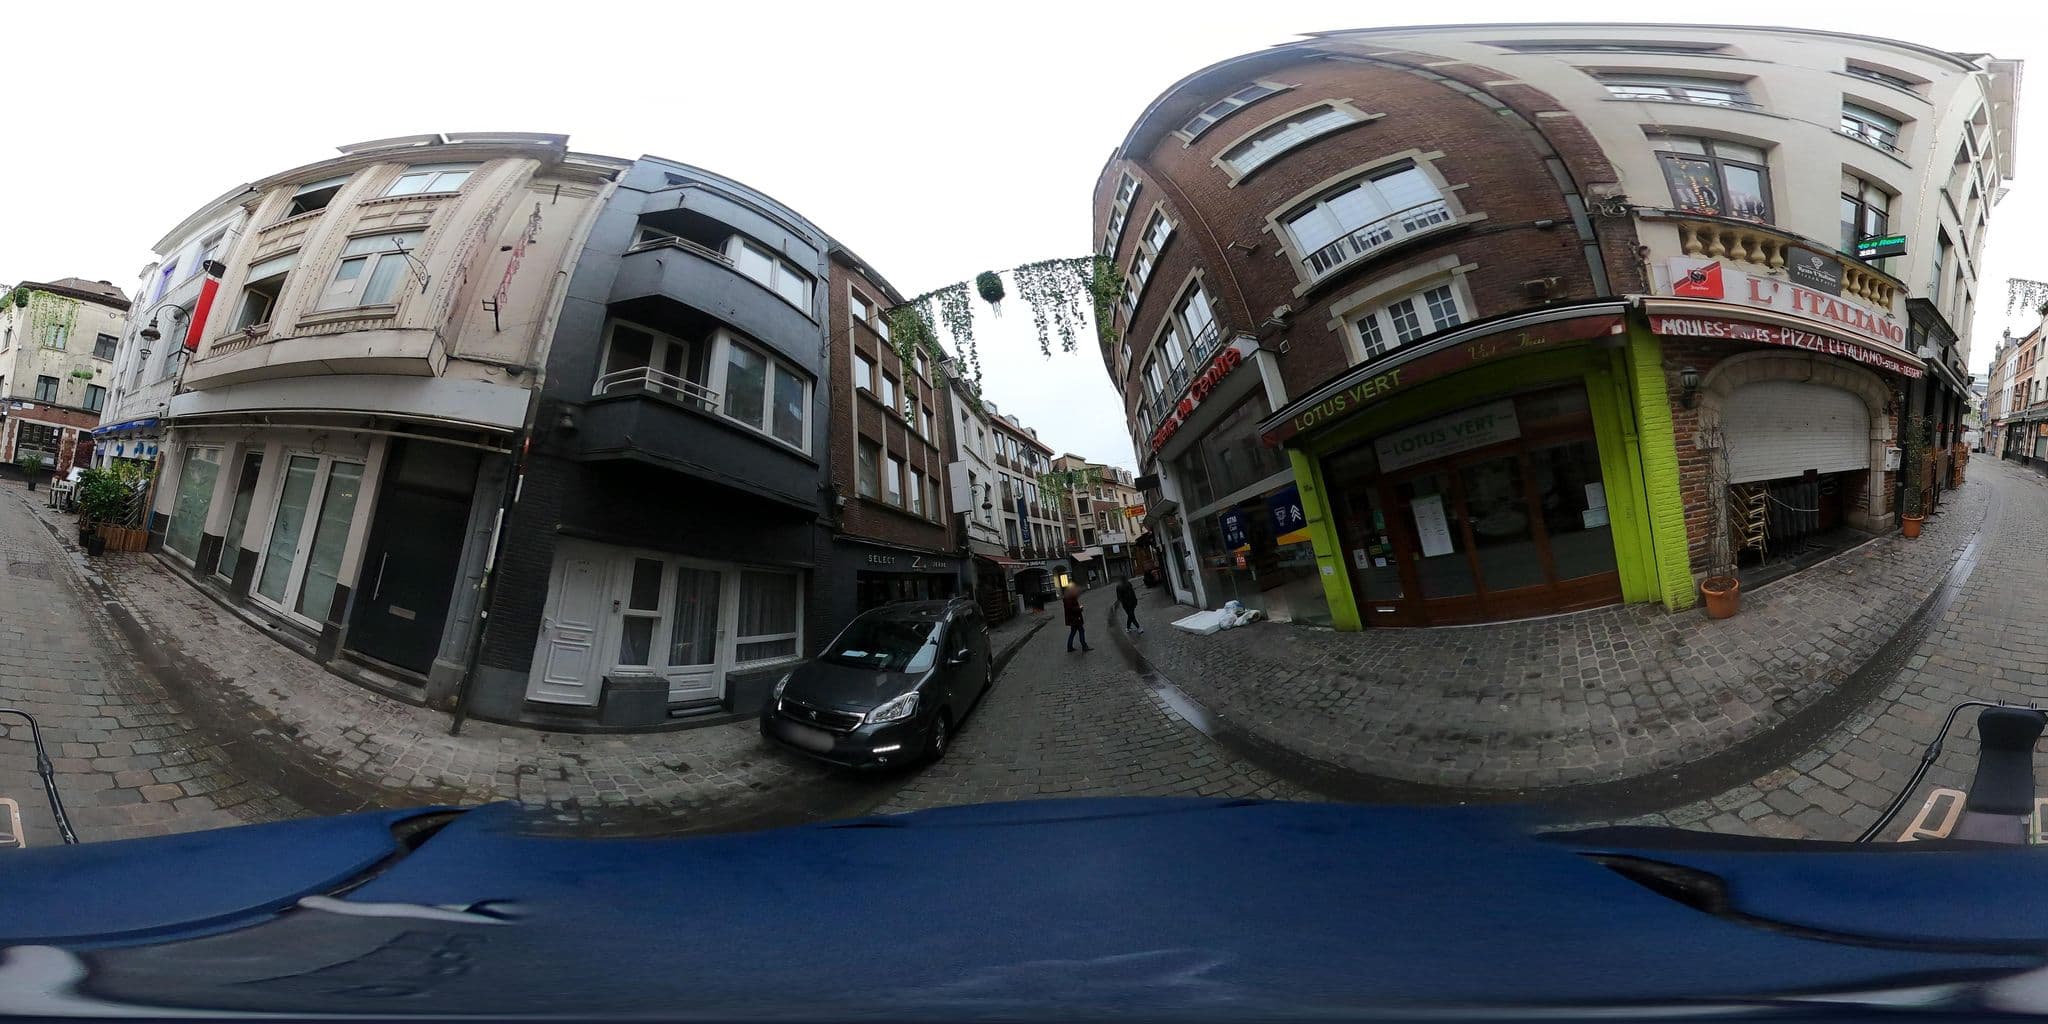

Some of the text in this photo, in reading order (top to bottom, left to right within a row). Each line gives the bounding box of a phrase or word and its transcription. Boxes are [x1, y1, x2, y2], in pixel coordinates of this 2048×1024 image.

[1791, 287, 1904, 343] ITALIANO
[1295, 369, 1401, 431] LOTUS VERT
[1393, 430, 1447, 456] LOTUS
[1450, 414, 1496, 436] VERT
[868, 554, 895, 565] SELECT
